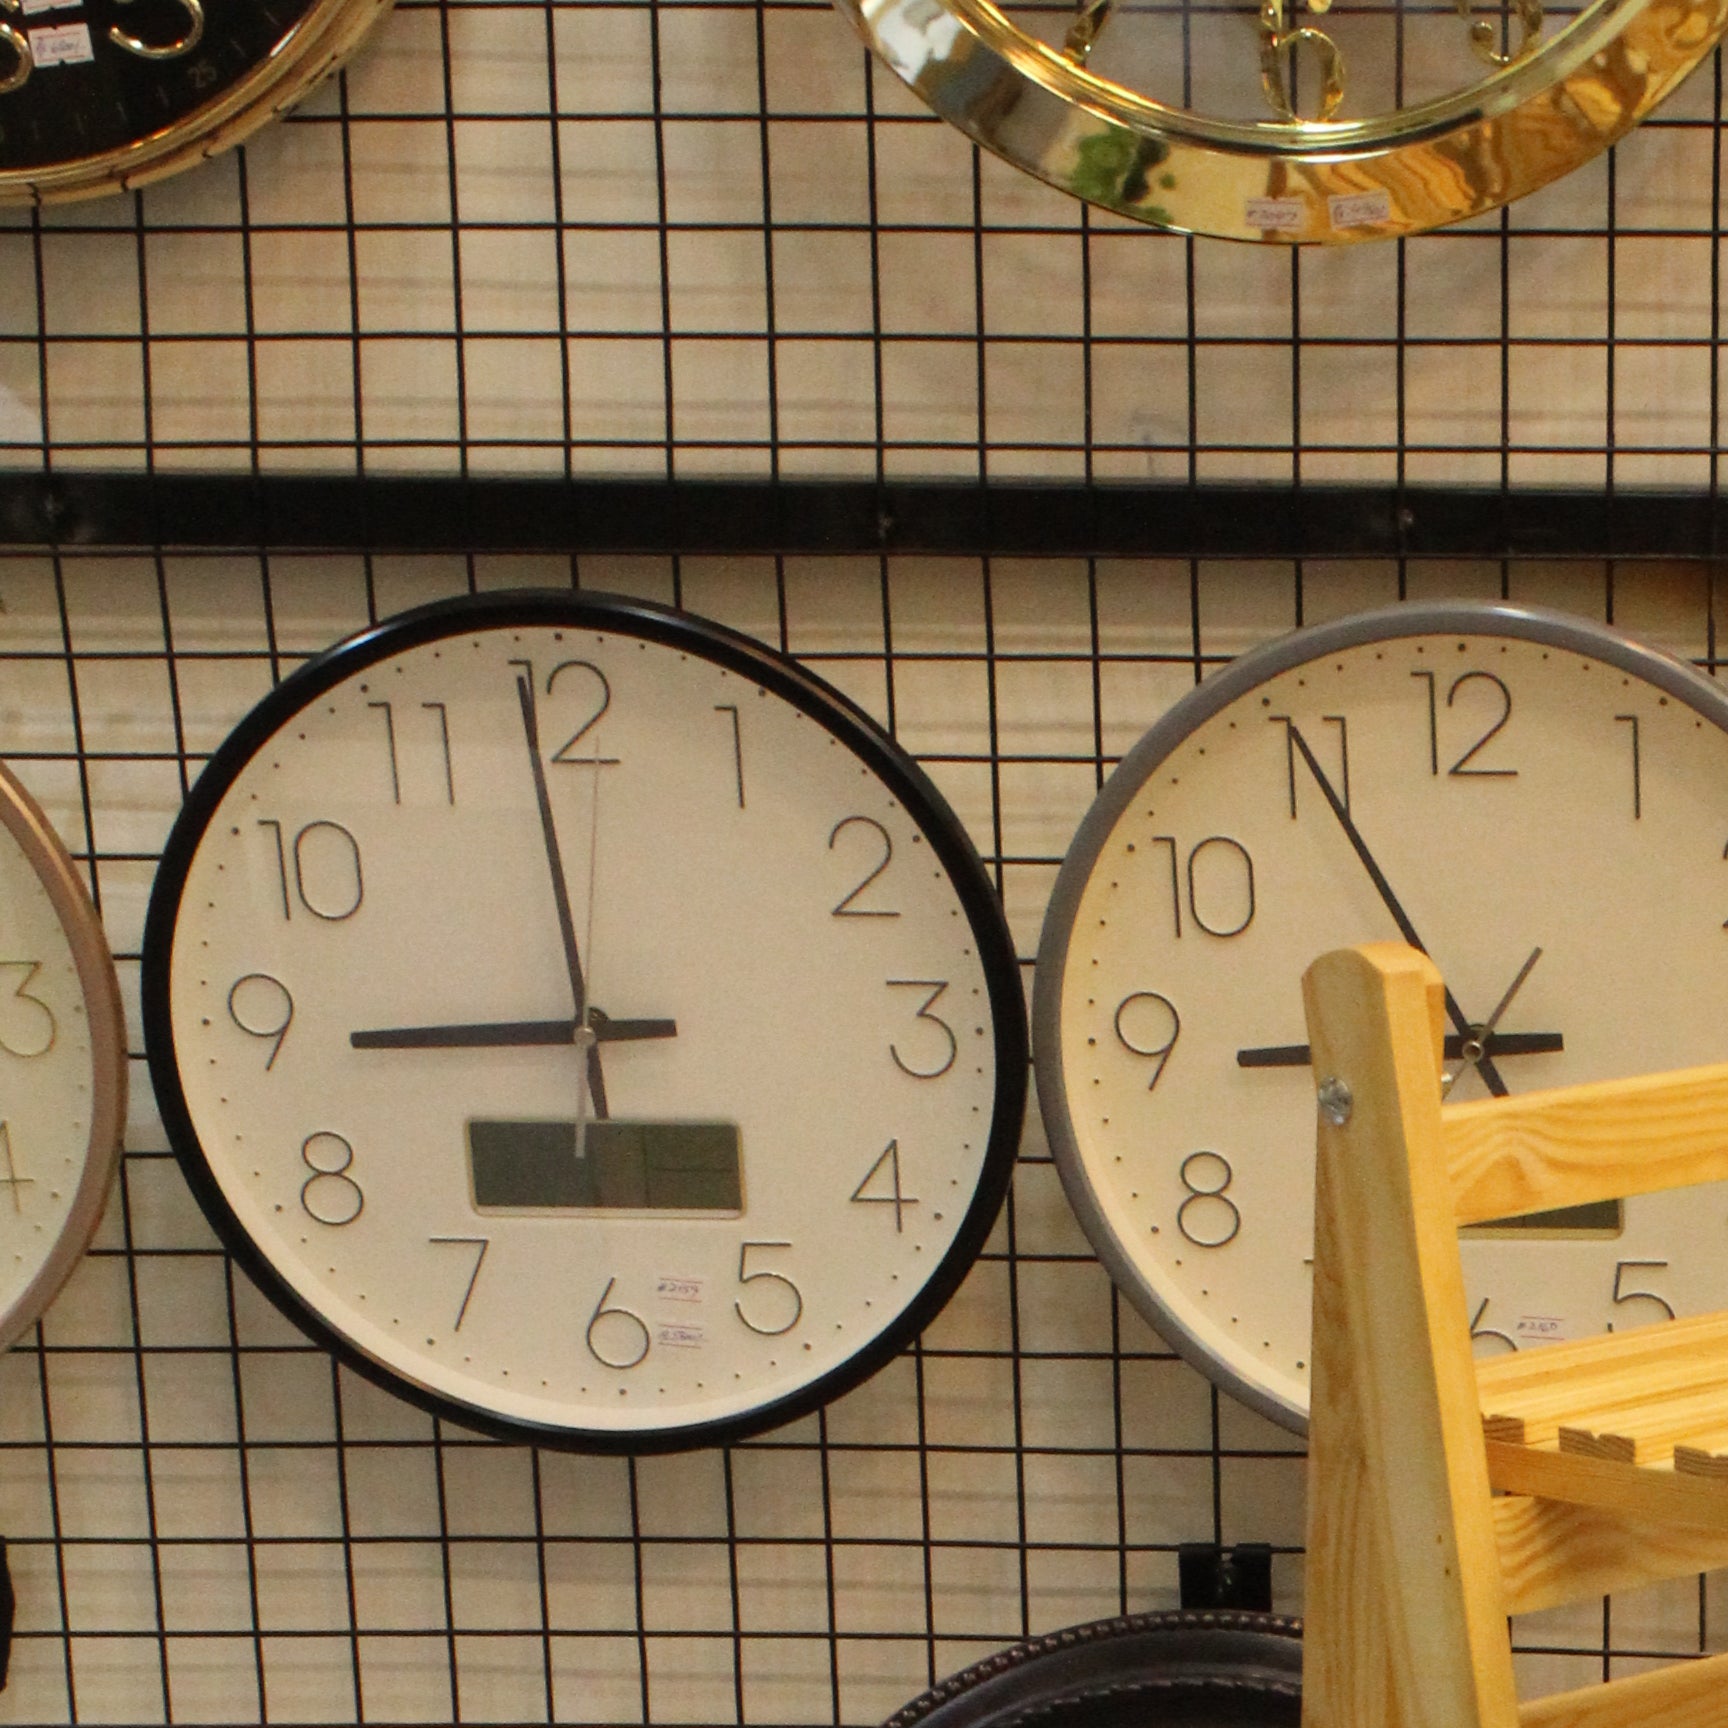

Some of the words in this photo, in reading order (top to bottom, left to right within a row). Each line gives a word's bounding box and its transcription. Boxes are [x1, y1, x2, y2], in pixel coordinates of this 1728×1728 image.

[367, 701, 455, 806] 11
[508, 659, 620, 764] 12
[714, 705, 746, 810] 1
[1410, 671, 1518, 776] 12
[1269, 716, 1351, 820] 11
[1614, 715, 1641, 819] 1
[256, 819, 364, 922] 10
[829, 816, 901, 917] 2
[1153, 836, 1255, 938] 10
[0, 961, 56, 1058] 3
[227, 973, 294, 1071] 9
[886, 980, 957, 1078] 3
[1114, 991, 1180, 1091] 9
[301, 1131, 364, 1226] 8
[850, 1139, 919, 1233] 4
[1177, 1150, 1241, 1247] 8
[429, 1238, 490, 1332] 7
[586, 1277, 651, 1369] 6
[735, 1242, 803, 1335] 5
